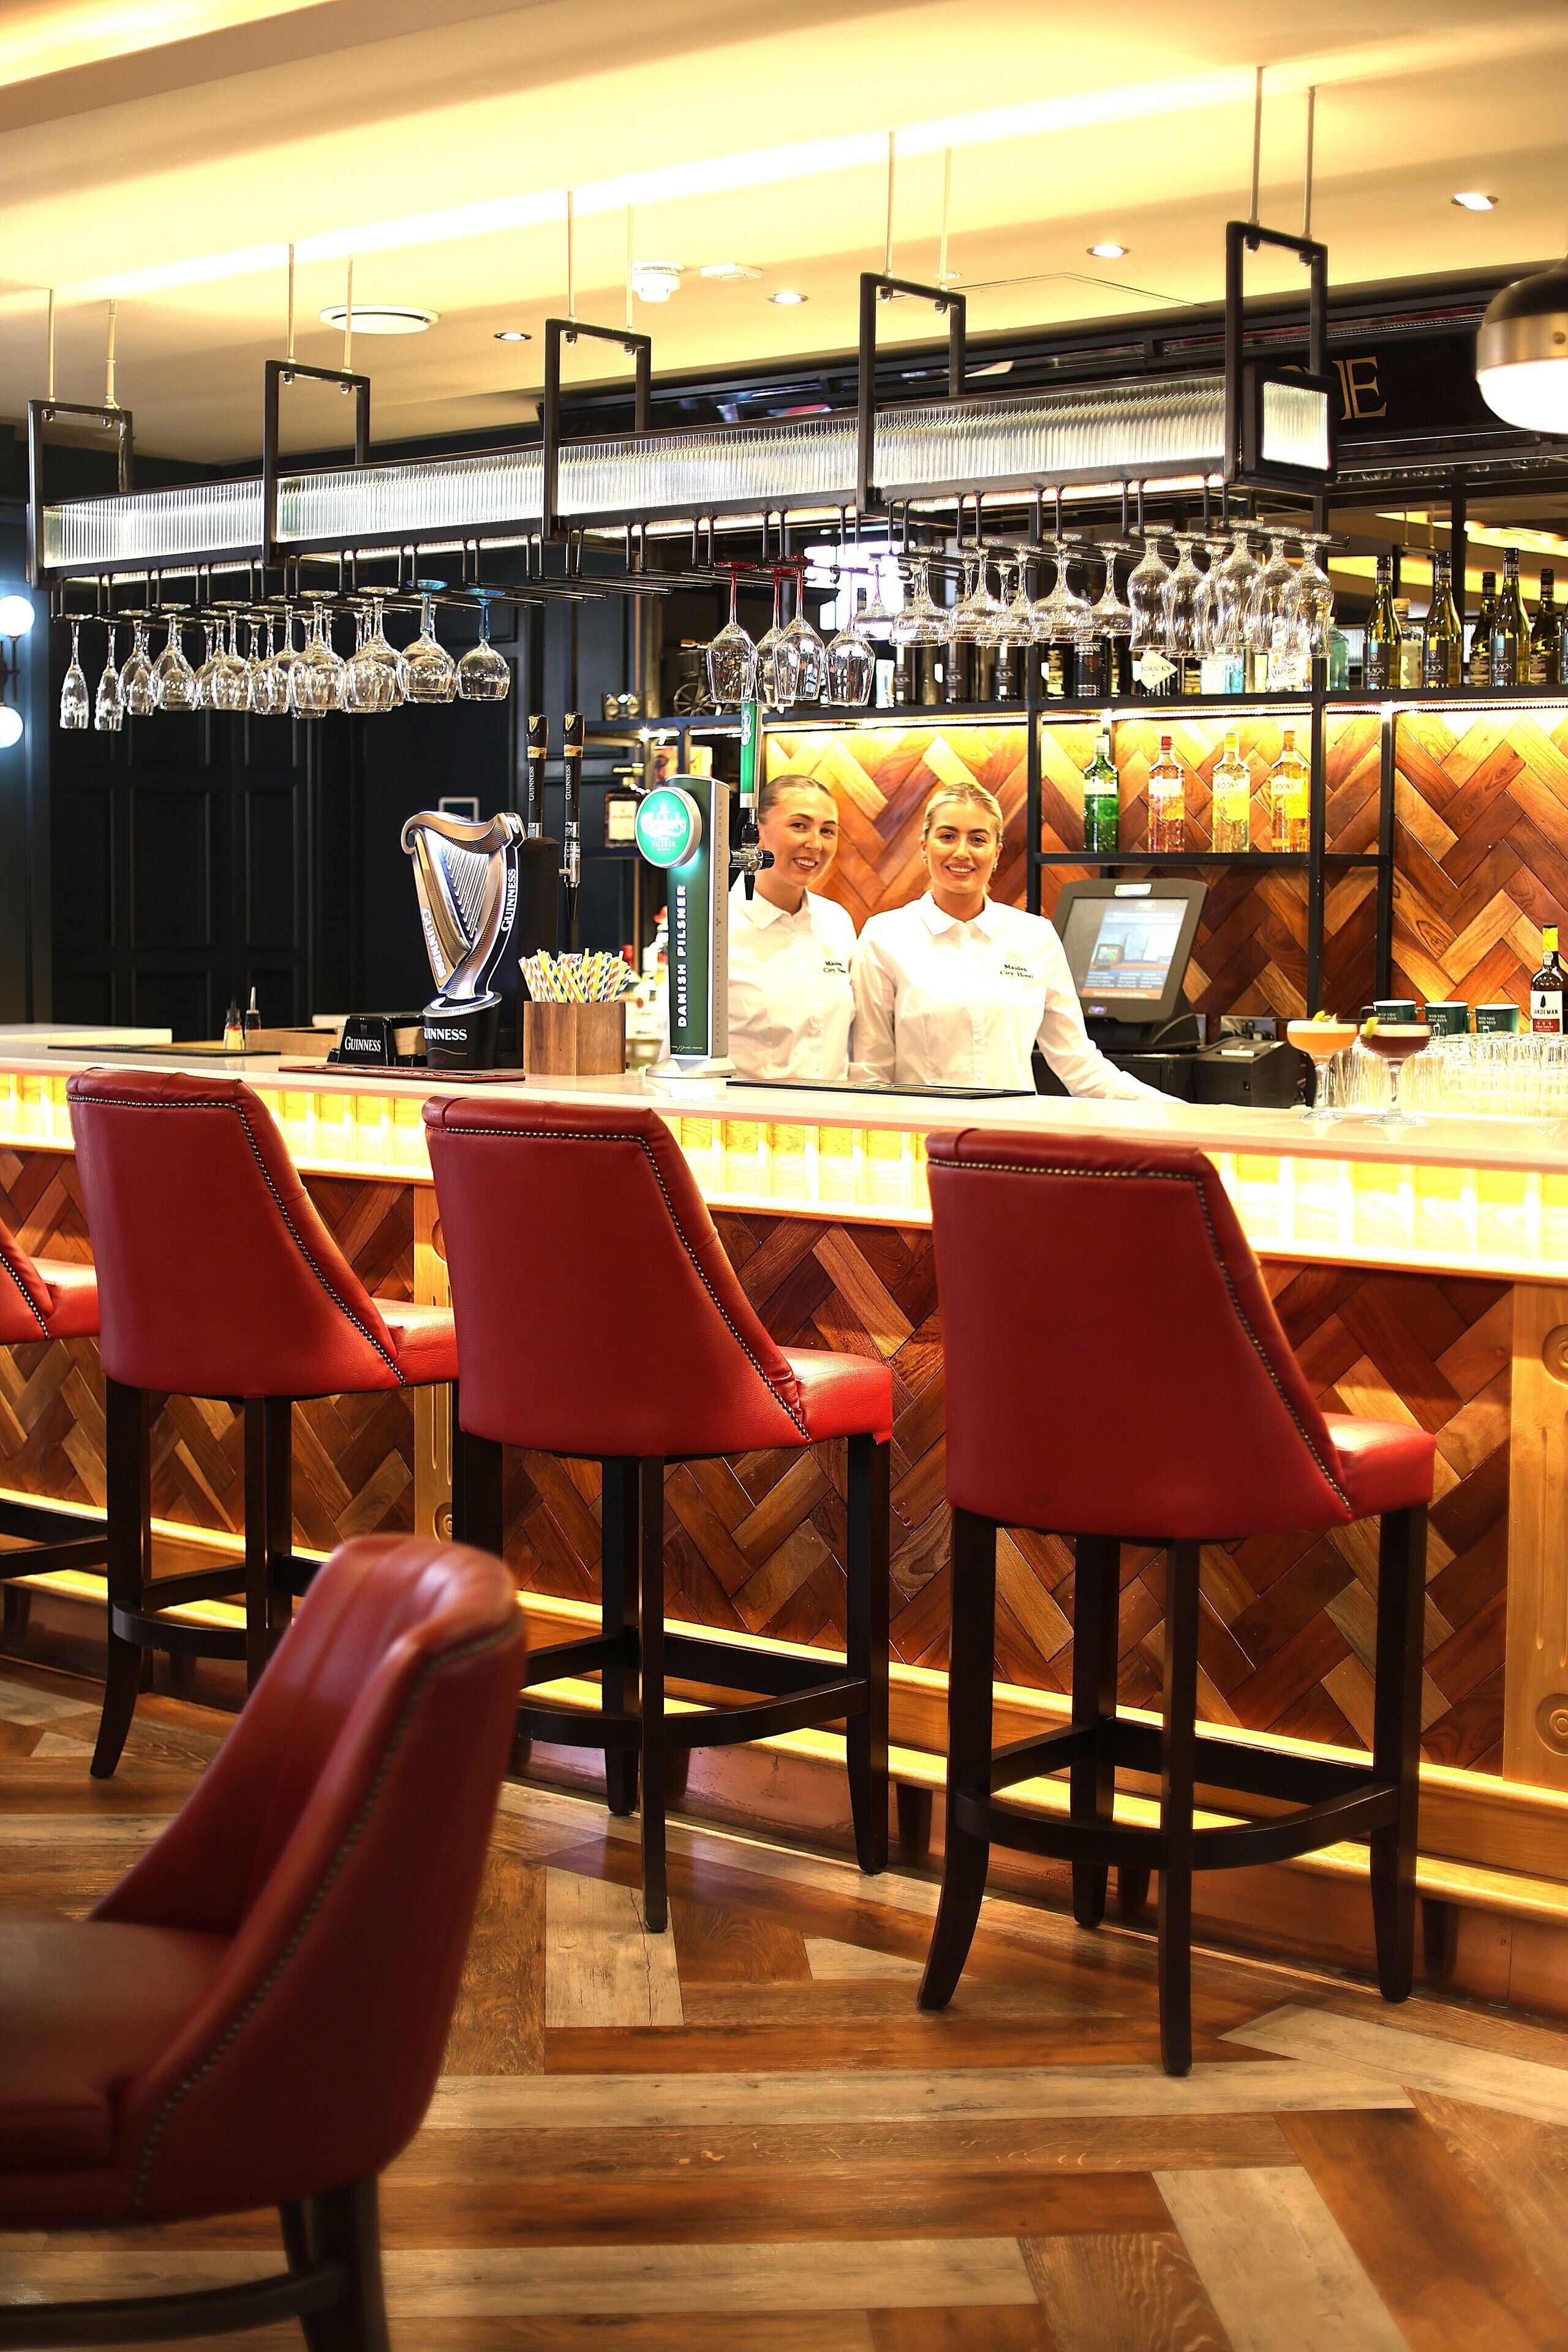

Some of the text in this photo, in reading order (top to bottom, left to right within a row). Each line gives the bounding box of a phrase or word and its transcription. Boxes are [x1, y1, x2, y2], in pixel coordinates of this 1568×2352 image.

[500, 869, 516, 932] GUINNESS
[718, 869, 722, 878] IN
[421, 908, 447, 979] GUINNESS
[676, 884, 687, 1028] DANISH PILSNER
[344, 1036, 381, 1052] GUINNESS
